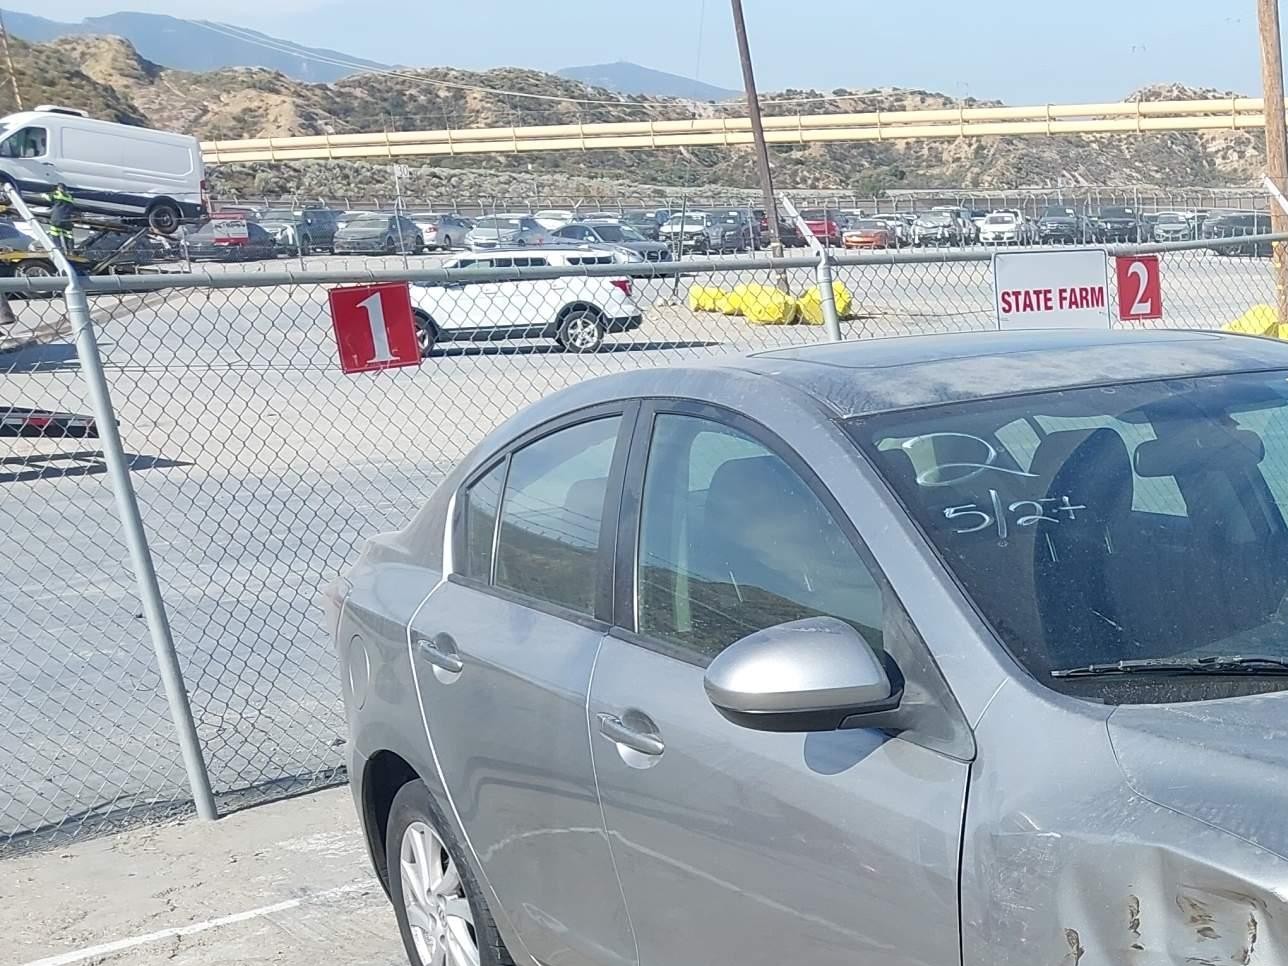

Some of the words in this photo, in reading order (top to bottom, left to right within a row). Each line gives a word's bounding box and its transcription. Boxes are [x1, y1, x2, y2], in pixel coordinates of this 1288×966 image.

[1001, 289, 1054, 314] STATE
[1058, 286, 1105, 310] FARM
[1127, 261, 1152, 315] 2
[355, 291, 401, 364] 1
